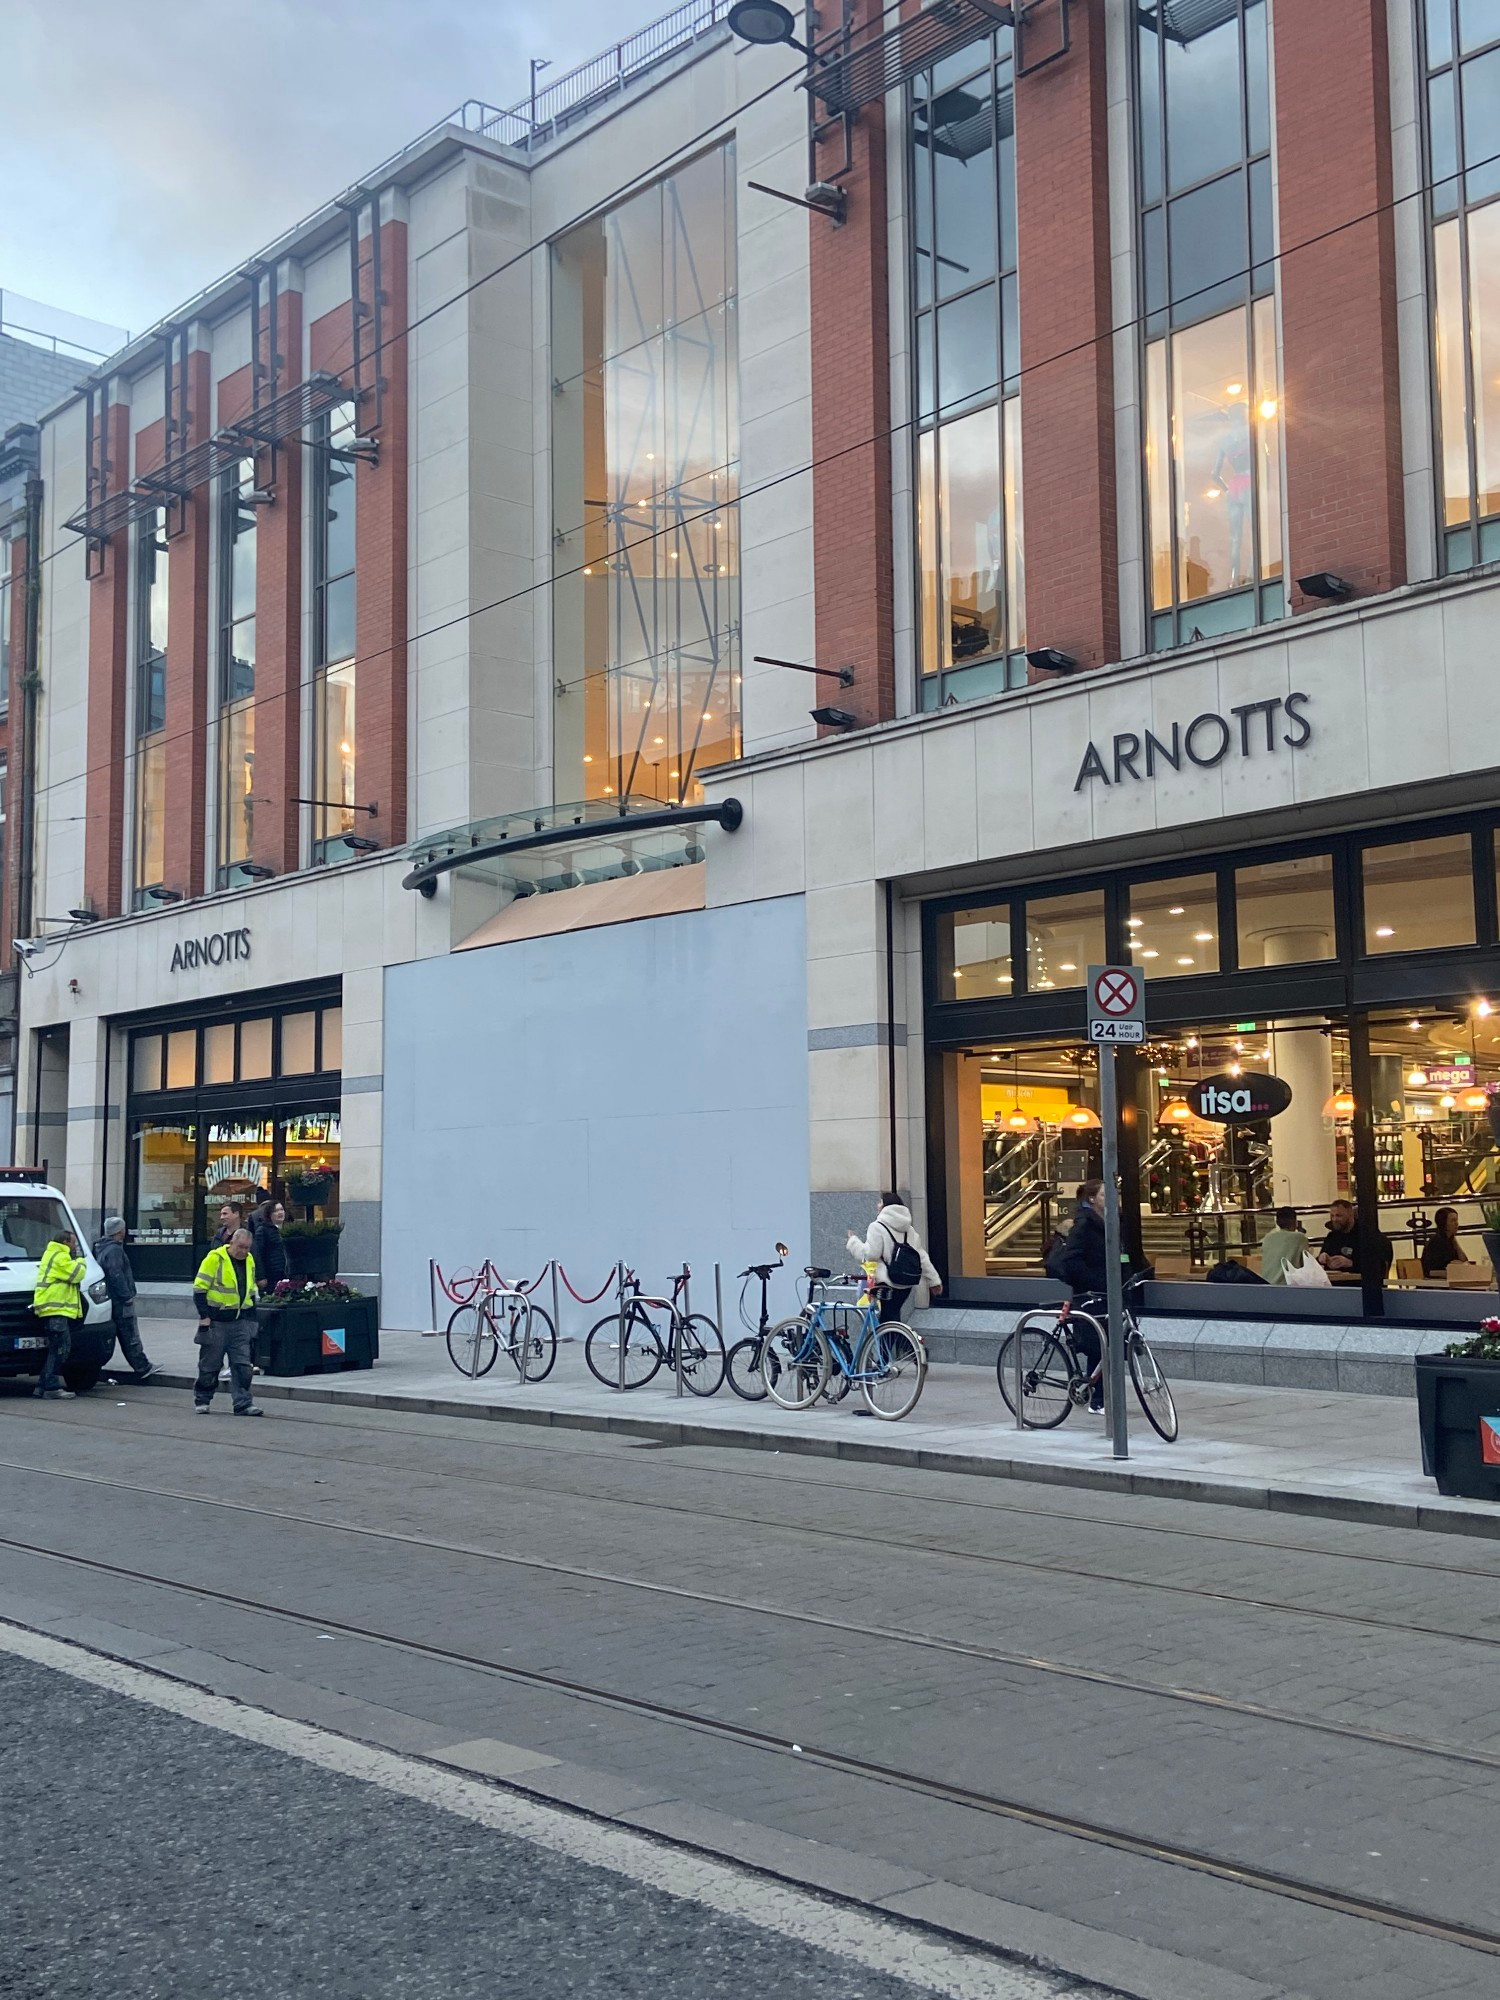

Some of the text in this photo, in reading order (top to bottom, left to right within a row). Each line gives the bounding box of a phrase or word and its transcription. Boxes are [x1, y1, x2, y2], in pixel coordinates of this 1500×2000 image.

[1073, 692, 1311, 792] ARNOTTS
[169, 927, 251, 973] ARNOTTS
[1094, 1023, 1116, 1038] 24
[1429, 1070, 1470, 1084] mega
